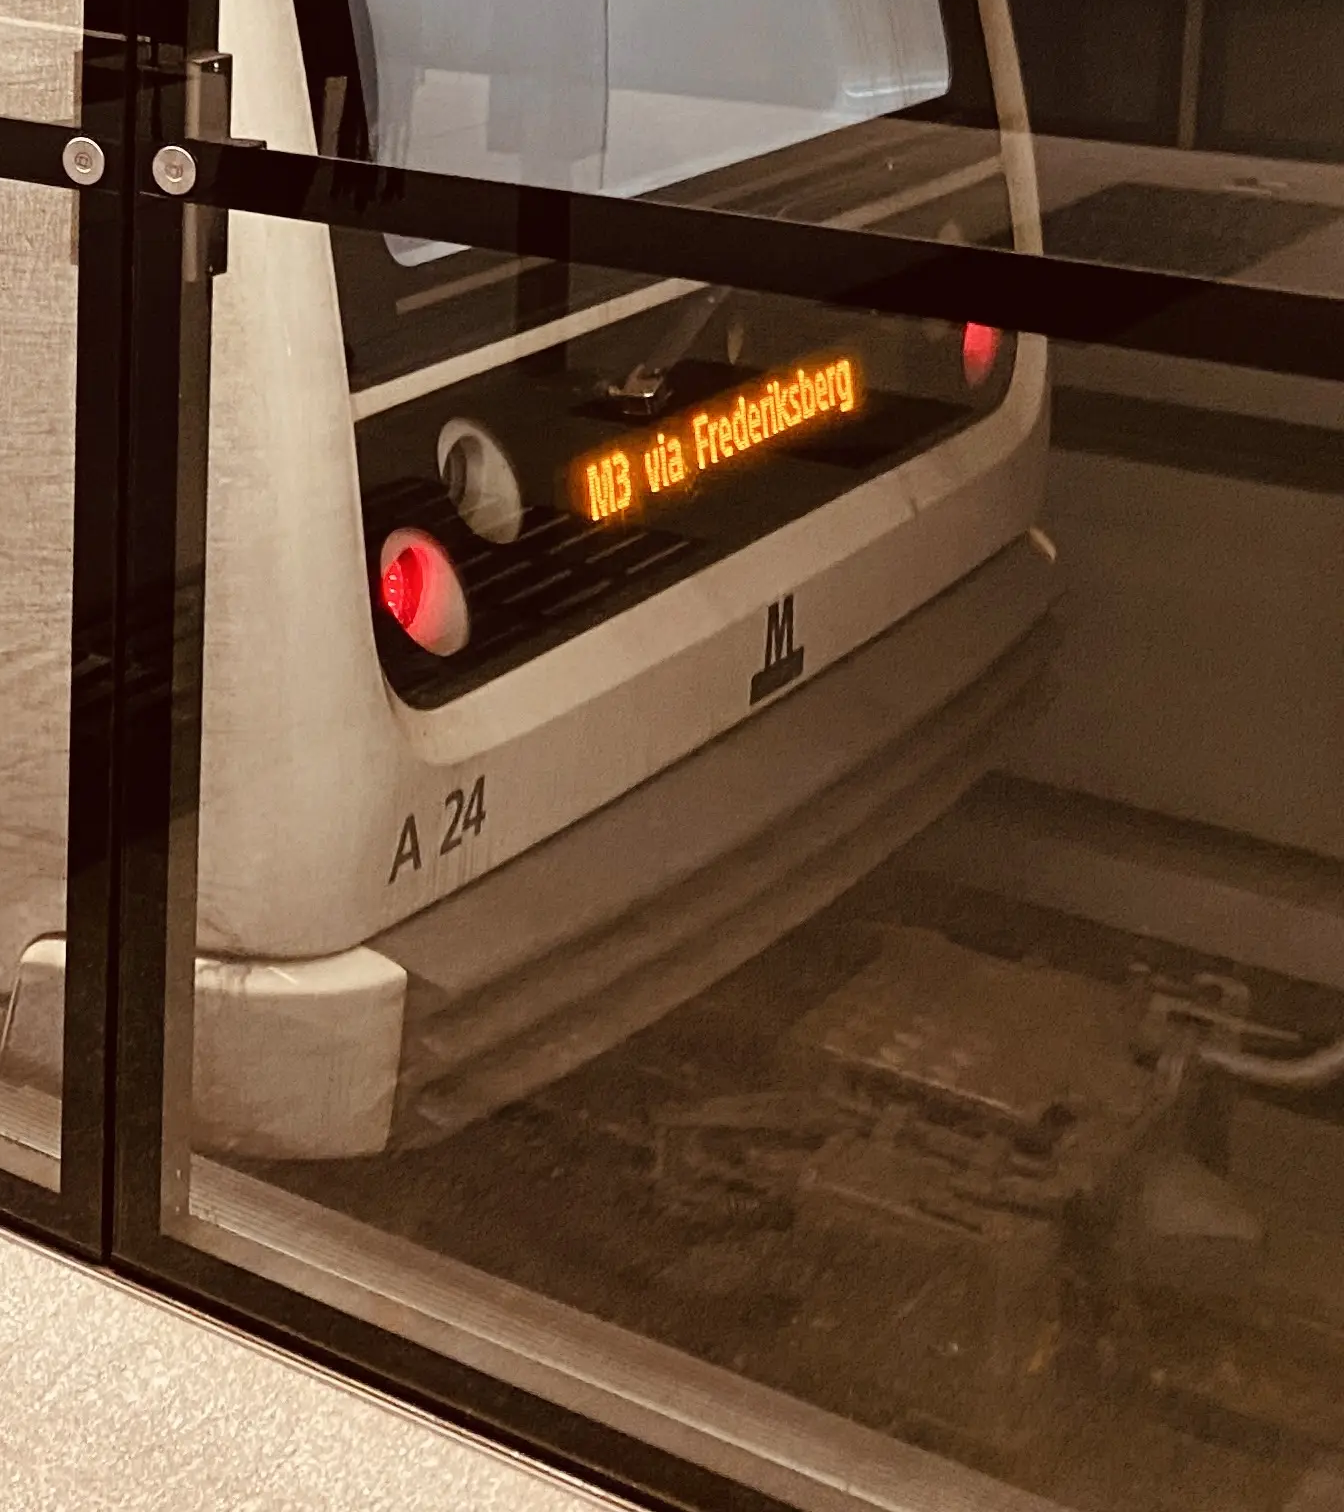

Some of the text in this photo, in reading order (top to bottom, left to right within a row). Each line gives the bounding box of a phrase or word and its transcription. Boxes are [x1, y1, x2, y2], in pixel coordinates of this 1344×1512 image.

[587, 359, 854, 521] M3 via Frederiksberg
[388, 774, 486, 885] A 24
